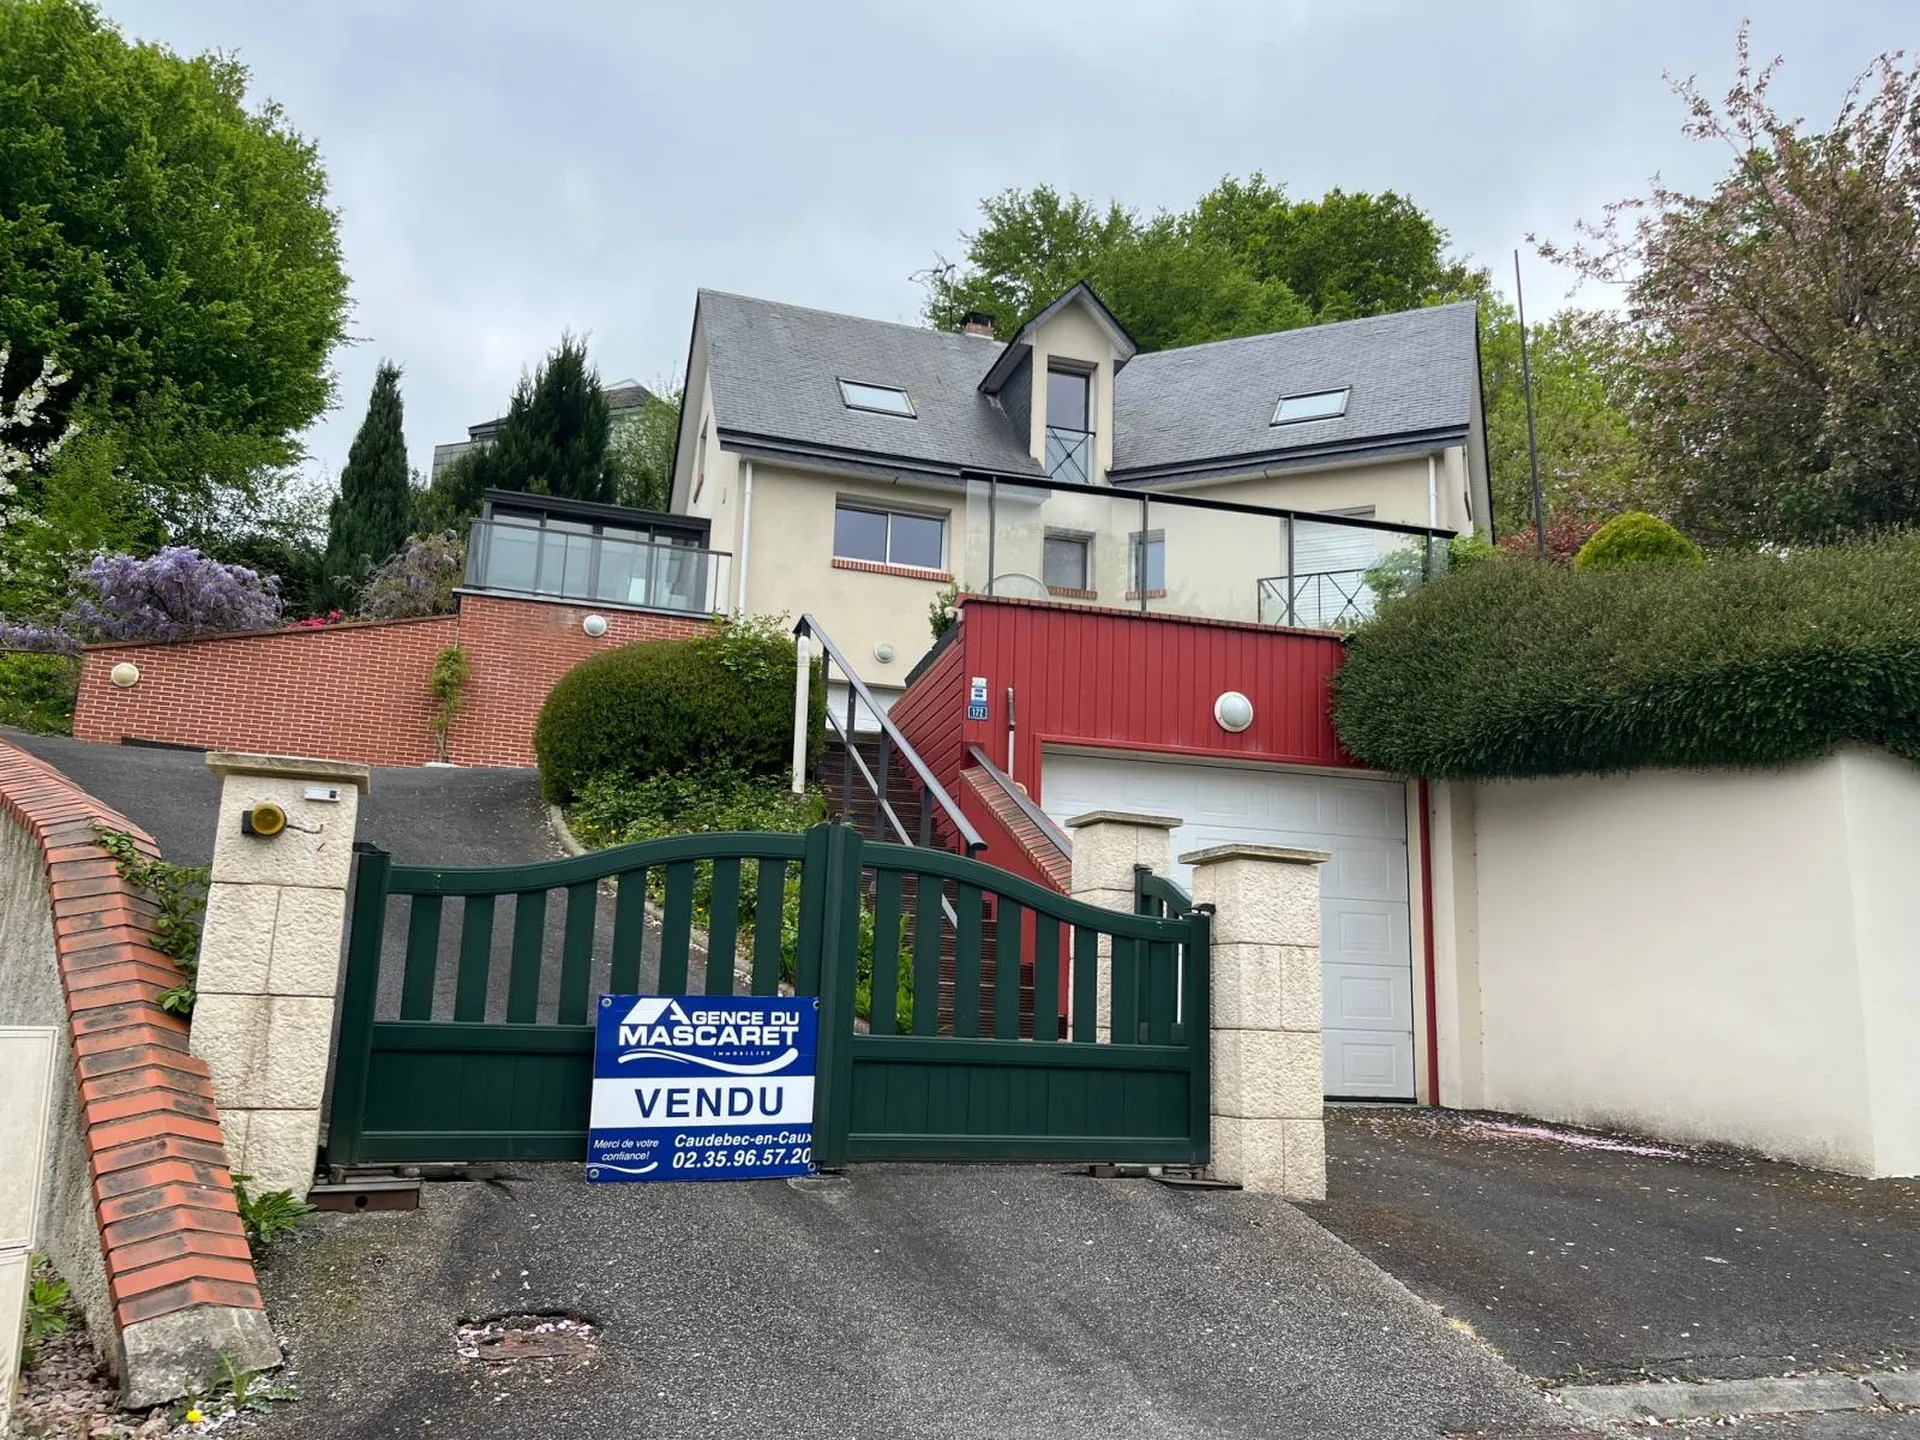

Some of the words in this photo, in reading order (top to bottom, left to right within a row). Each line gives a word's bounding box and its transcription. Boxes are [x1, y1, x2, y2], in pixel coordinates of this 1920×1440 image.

[669, 999, 764, 1025] AGENCE
[770, 1011, 799, 1025] DU
[618, 1026, 799, 1046] MASCARET
[634, 1086, 784, 1119] VENDU
[593, 1139, 620, 1149] Merci
[621, 1138, 634, 1148] de
[636, 1138, 660, 1148] votre
[674, 1131, 812, 1147] Caudebec-en-Caux
[601, 1150, 650, 1161] confiance!
[672, 1147, 812, 1168] 02.35.96.57.20
